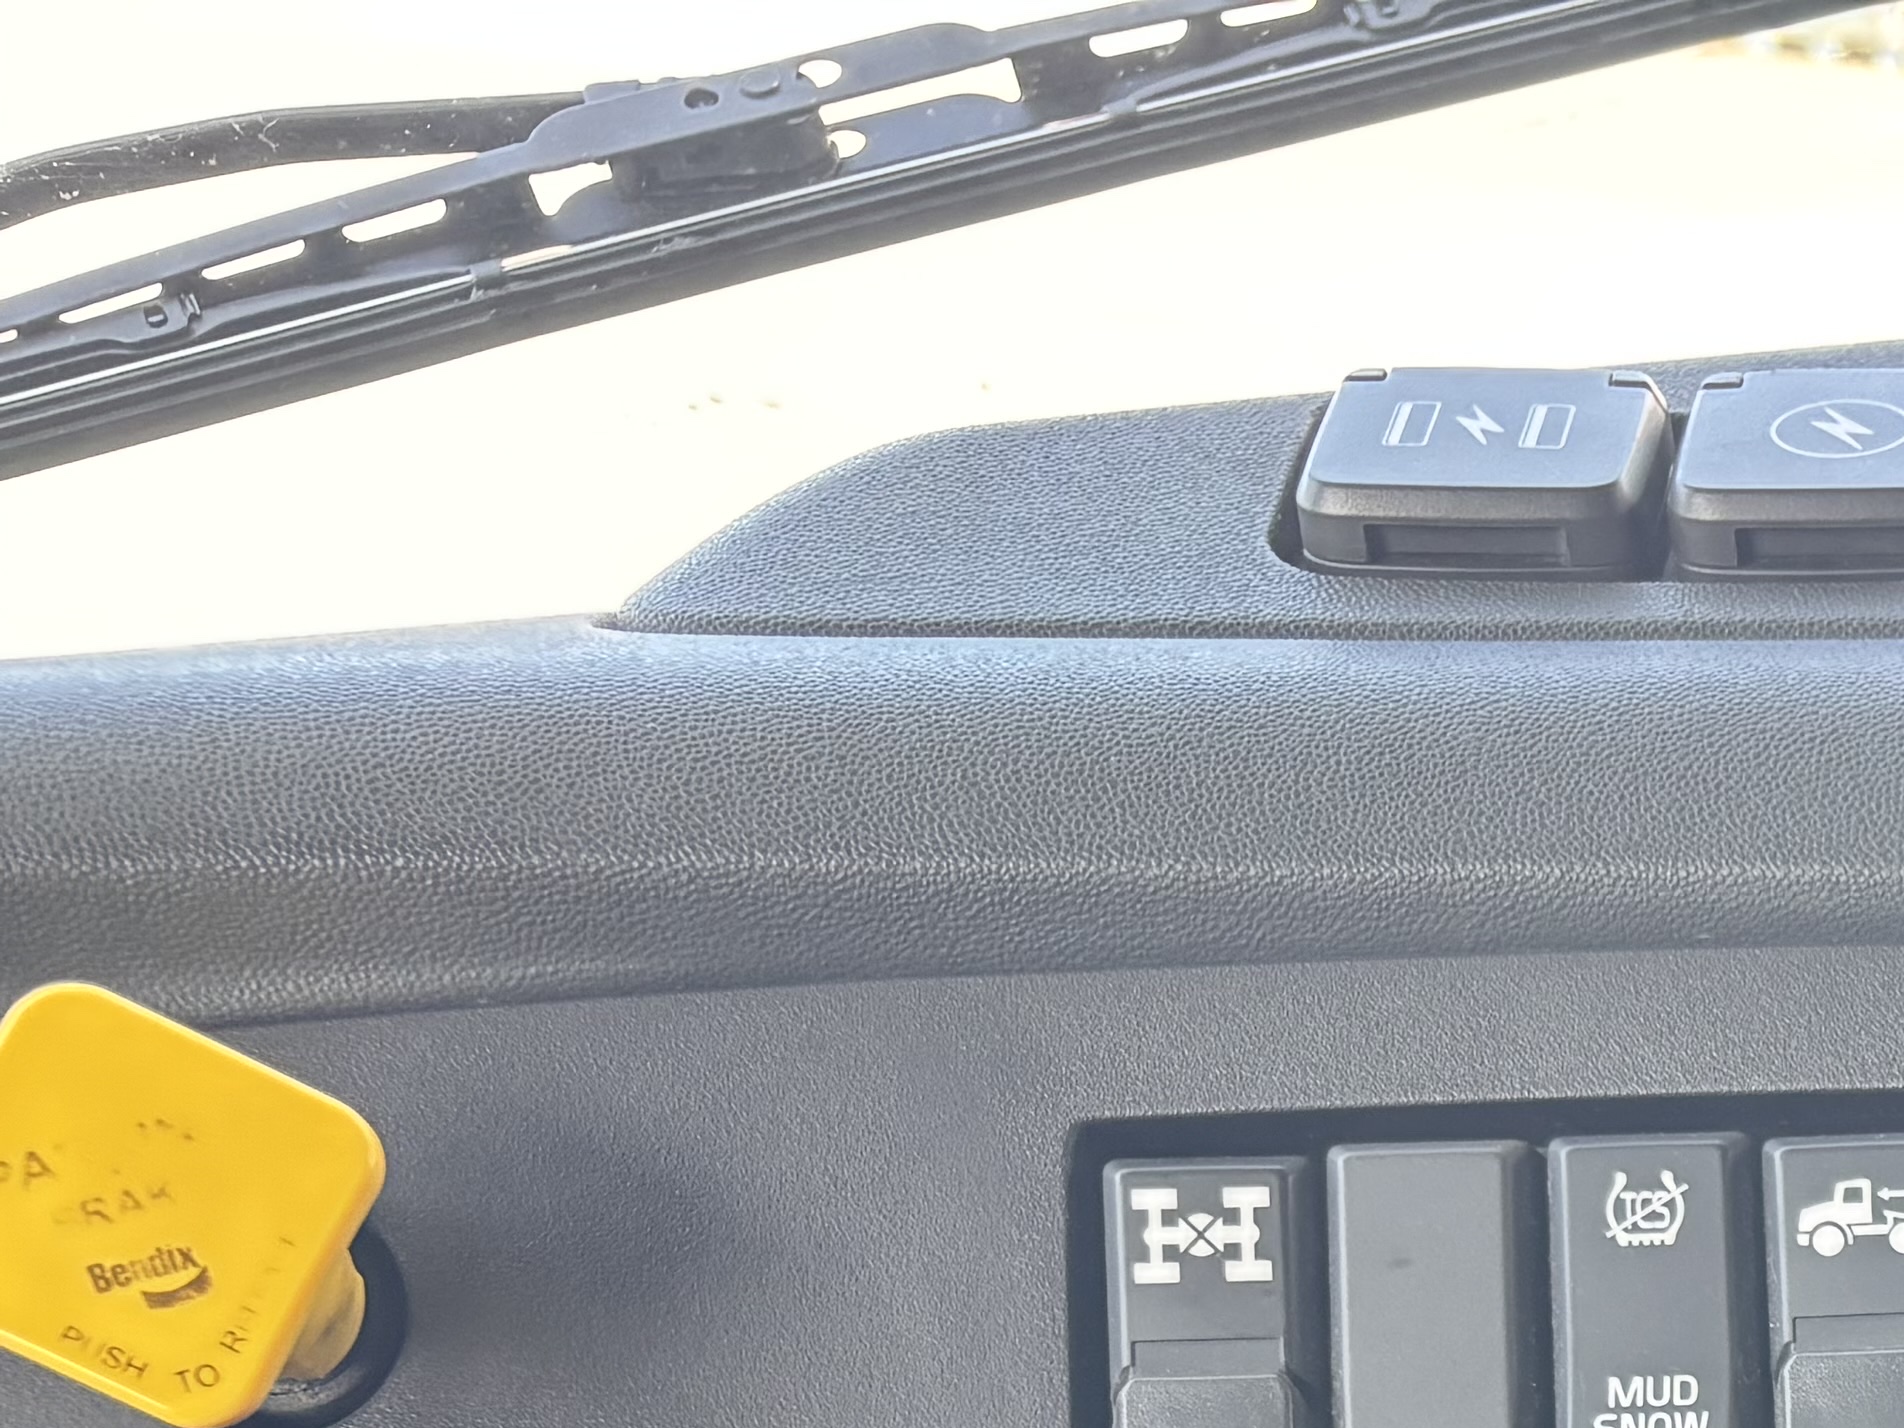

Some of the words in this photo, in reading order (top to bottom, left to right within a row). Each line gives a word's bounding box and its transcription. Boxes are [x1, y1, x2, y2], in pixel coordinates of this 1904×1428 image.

[87, 1246, 201, 1293] Bendix
[174, 1364, 221, 1393] TO
[1607, 1374, 1699, 1409] MUD
